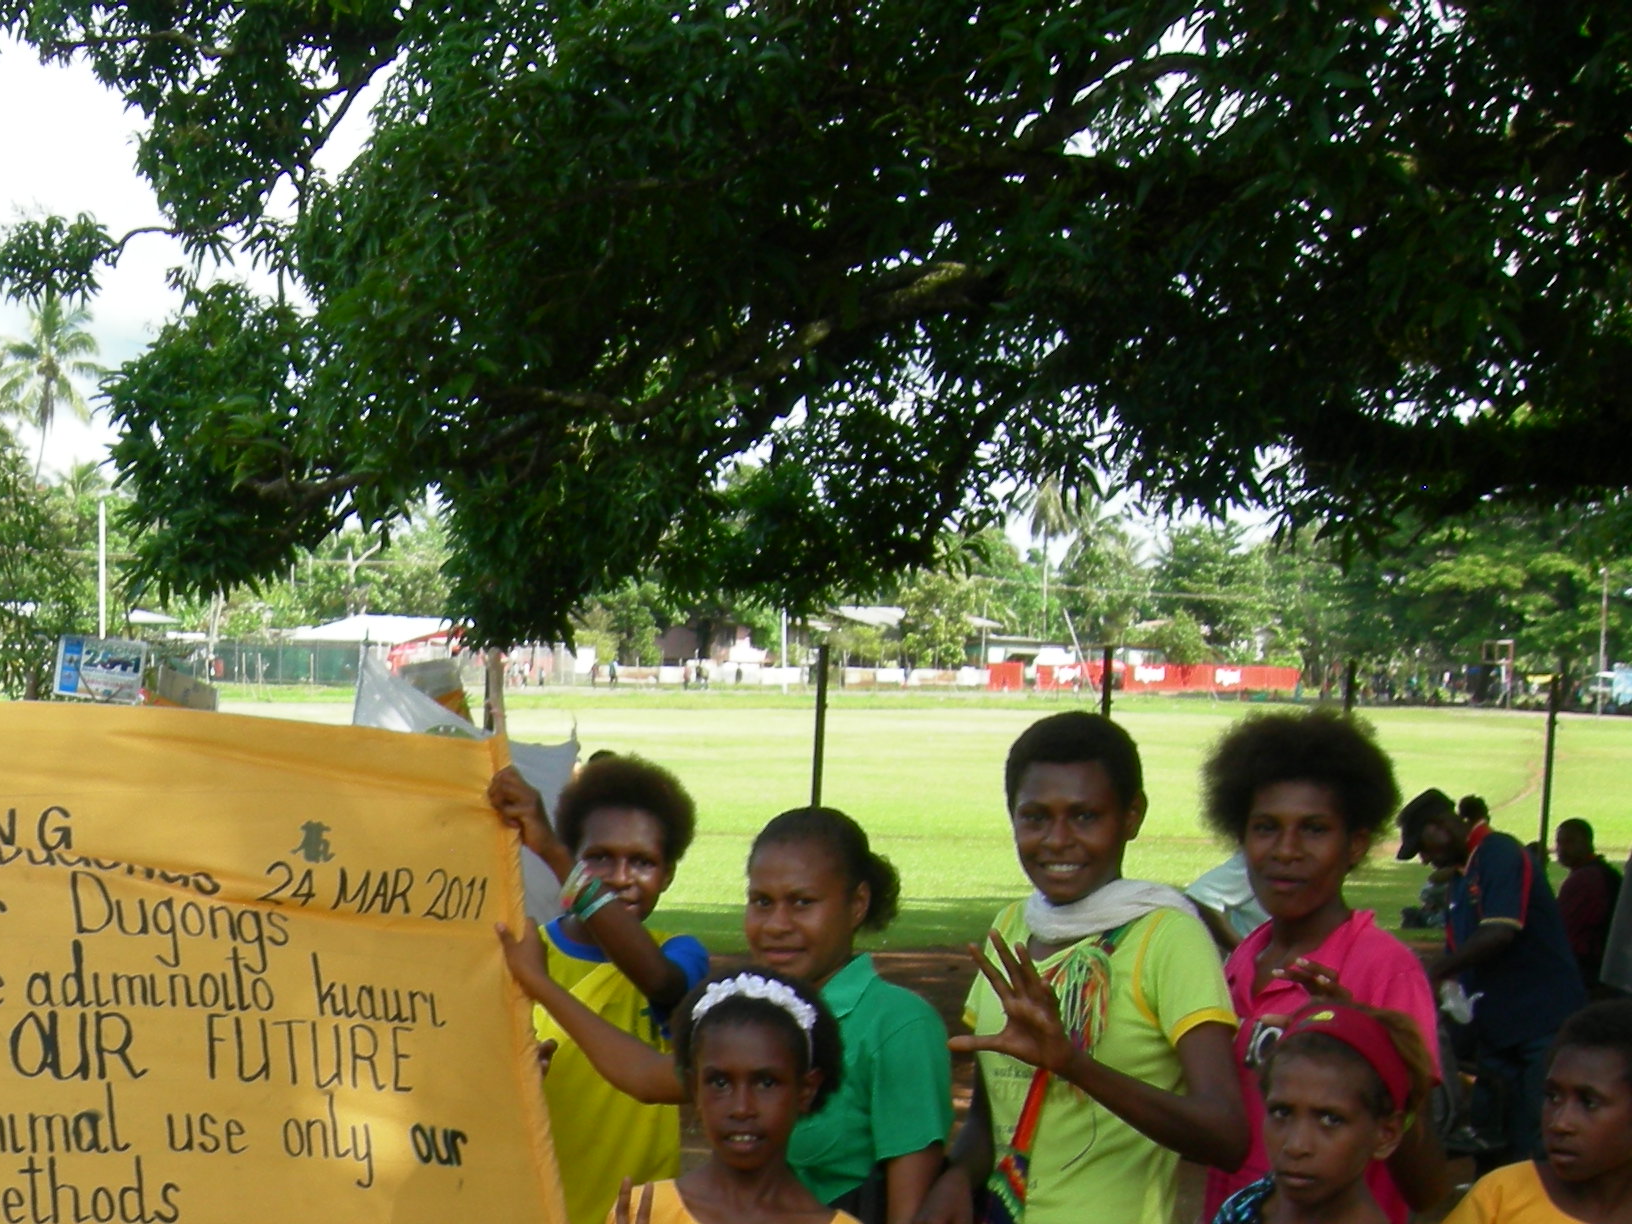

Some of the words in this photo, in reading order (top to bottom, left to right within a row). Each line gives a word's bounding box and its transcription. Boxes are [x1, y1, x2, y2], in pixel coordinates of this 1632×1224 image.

[70, 870, 289, 975] Dugongs
[255, 860, 316, 907] 24
[330, 867, 414, 915] MAR
[423, 868, 488, 920] 2011
[9, 1009, 149, 1081] OUR
[207, 1013, 414, 1093] FUTURE
[165, 1108, 250, 1155] use
[282, 1090, 374, 1189] only
[409, 1121, 469, 1168] our
